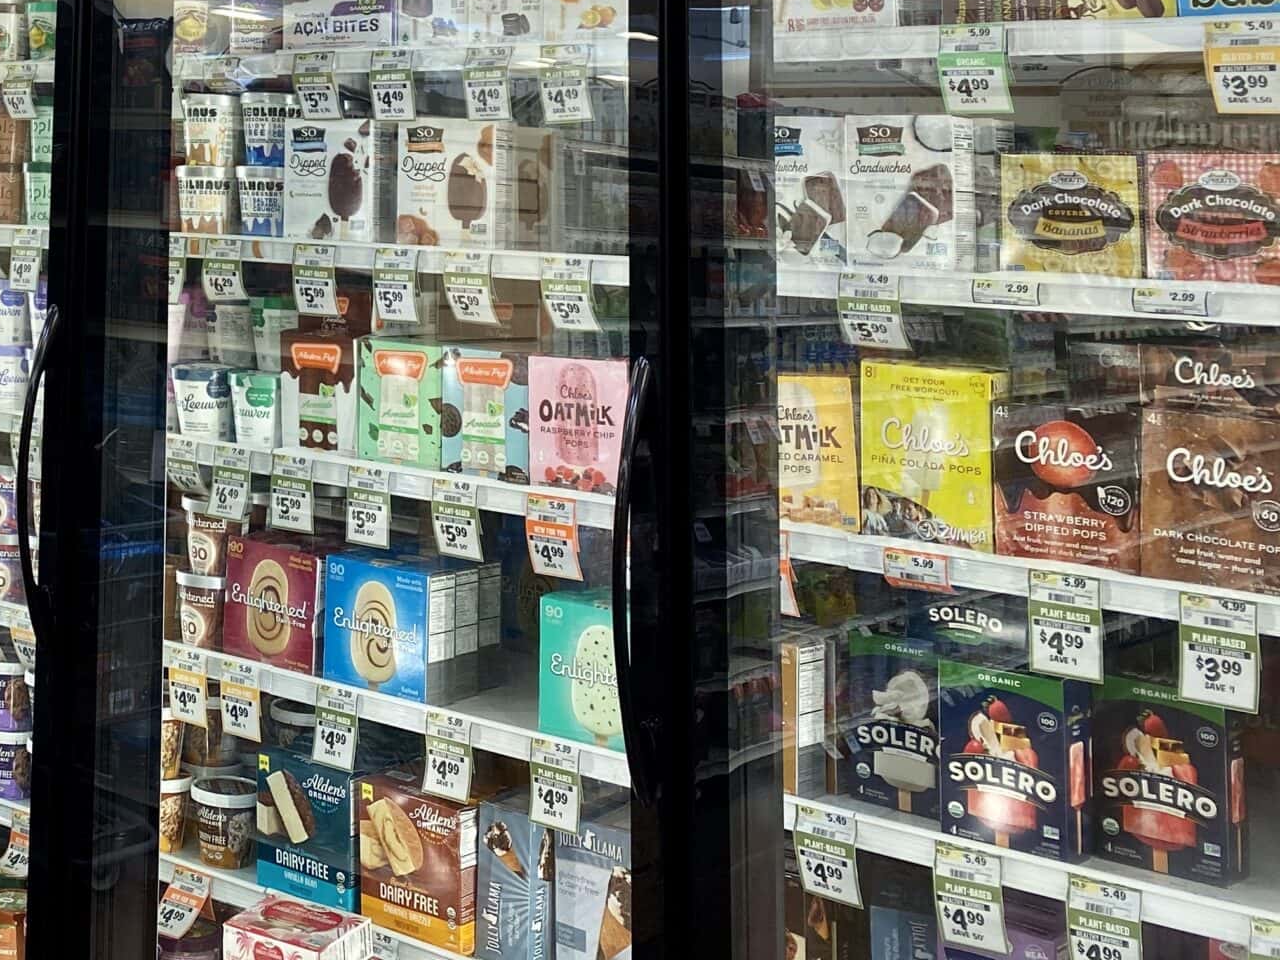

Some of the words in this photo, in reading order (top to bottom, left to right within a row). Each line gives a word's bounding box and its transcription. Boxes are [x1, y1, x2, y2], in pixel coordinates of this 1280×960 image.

[333, 18, 379, 33] BITES
[301, 128, 317, 137] SO
[416, 128, 434, 137] SO
[869, 128, 890, 137] SO
[289, 154, 327, 176] Dipped
[401, 155, 447, 181] Dipped
[850, 160, 911, 174] Sandwiches
[1021, 197, 1052, 216] Dark
[1053, 193, 1121, 218] Chocolate
[1170, 200, 1202, 218] Dark
[1205, 194, 1276, 220] Chocolate
[1042, 222, 1100, 236] Bananas
[1182, 222, 1262, 240] Strawberries
[848, 303, 891, 312] PLANT-BASED
[865, 366, 873, 378] 8
[1174, 356, 1256, 388] Chloe's
[560, 384, 592, 400] Chloe's
[540, 426, 591, 439] RASPBERRY
[593, 430, 615, 440] CHIP
[881, 417, 969, 457] Chloe's
[565, 439, 588, 449] POPS
[1015, 431, 1113, 472] Chloe's
[794, 453, 843, 464] CARAMEL
[871, 454, 895, 465] PIÑA
[900, 458, 945, 471] COLADA
[949, 464, 981, 476] POPS
[784, 465, 811, 474] POPS
[1167, 447, 1273, 493] Chloe's
[1107, 496, 1124, 508] 120
[1024, 511, 1107, 528] STRAWBERRY
[940, 524, 987, 544] ZUMBA
[1025, 522, 1070, 537] DIPPED
[1072, 529, 1107, 541] POPS
[1153, 528, 1183, 540] DARK
[1187, 533, 1255, 551] CHOCOLATE
[1258, 538, 1280, 554] POP
[192, 545, 208, 560] 90
[329, 563, 344, 575] 90
[231, 583, 308, 620] Enlightened
[544, 604, 563, 618] 90
[929, 606, 1003, 632] SOLERO
[1040, 607, 1090, 623] PLANT-BASED
[333, 607, 417, 644] Enlightened
[884, 643, 924, 657] ORGANIC
[1192, 633, 1246, 650] PLANT-BASED
[1050, 654, 1069, 664] SAVE
[978, 673, 1021, 687] ORGANIC
[1204, 682, 1226, 692] SAVE
[1132, 686, 1177, 701] ORGANIC
[1040, 718, 1055, 726] 100
[1200, 733, 1215, 741] 100
[302, 773, 346, 798] Alden's
[948, 762, 1057, 803] SOLERO
[308, 790, 340, 805] ORGANIC
[1102, 776, 1218, 819] SOLERO
[409, 804, 458, 830] Alden's
[416, 820, 450, 837] ORGANIC
[804, 839, 846, 856] PLANT-BASED
[276, 849, 305, 873] DAIRY
[306, 860, 329, 881] FREE
[380, 882, 412, 905] DAIRY
[413, 896, 439, 916] FREE
[945, 883, 992, 900] PLANT-BASED
[1078, 916, 1131, 936] PLANT-BASED
[486, 922, 503, 955] JOLLY
